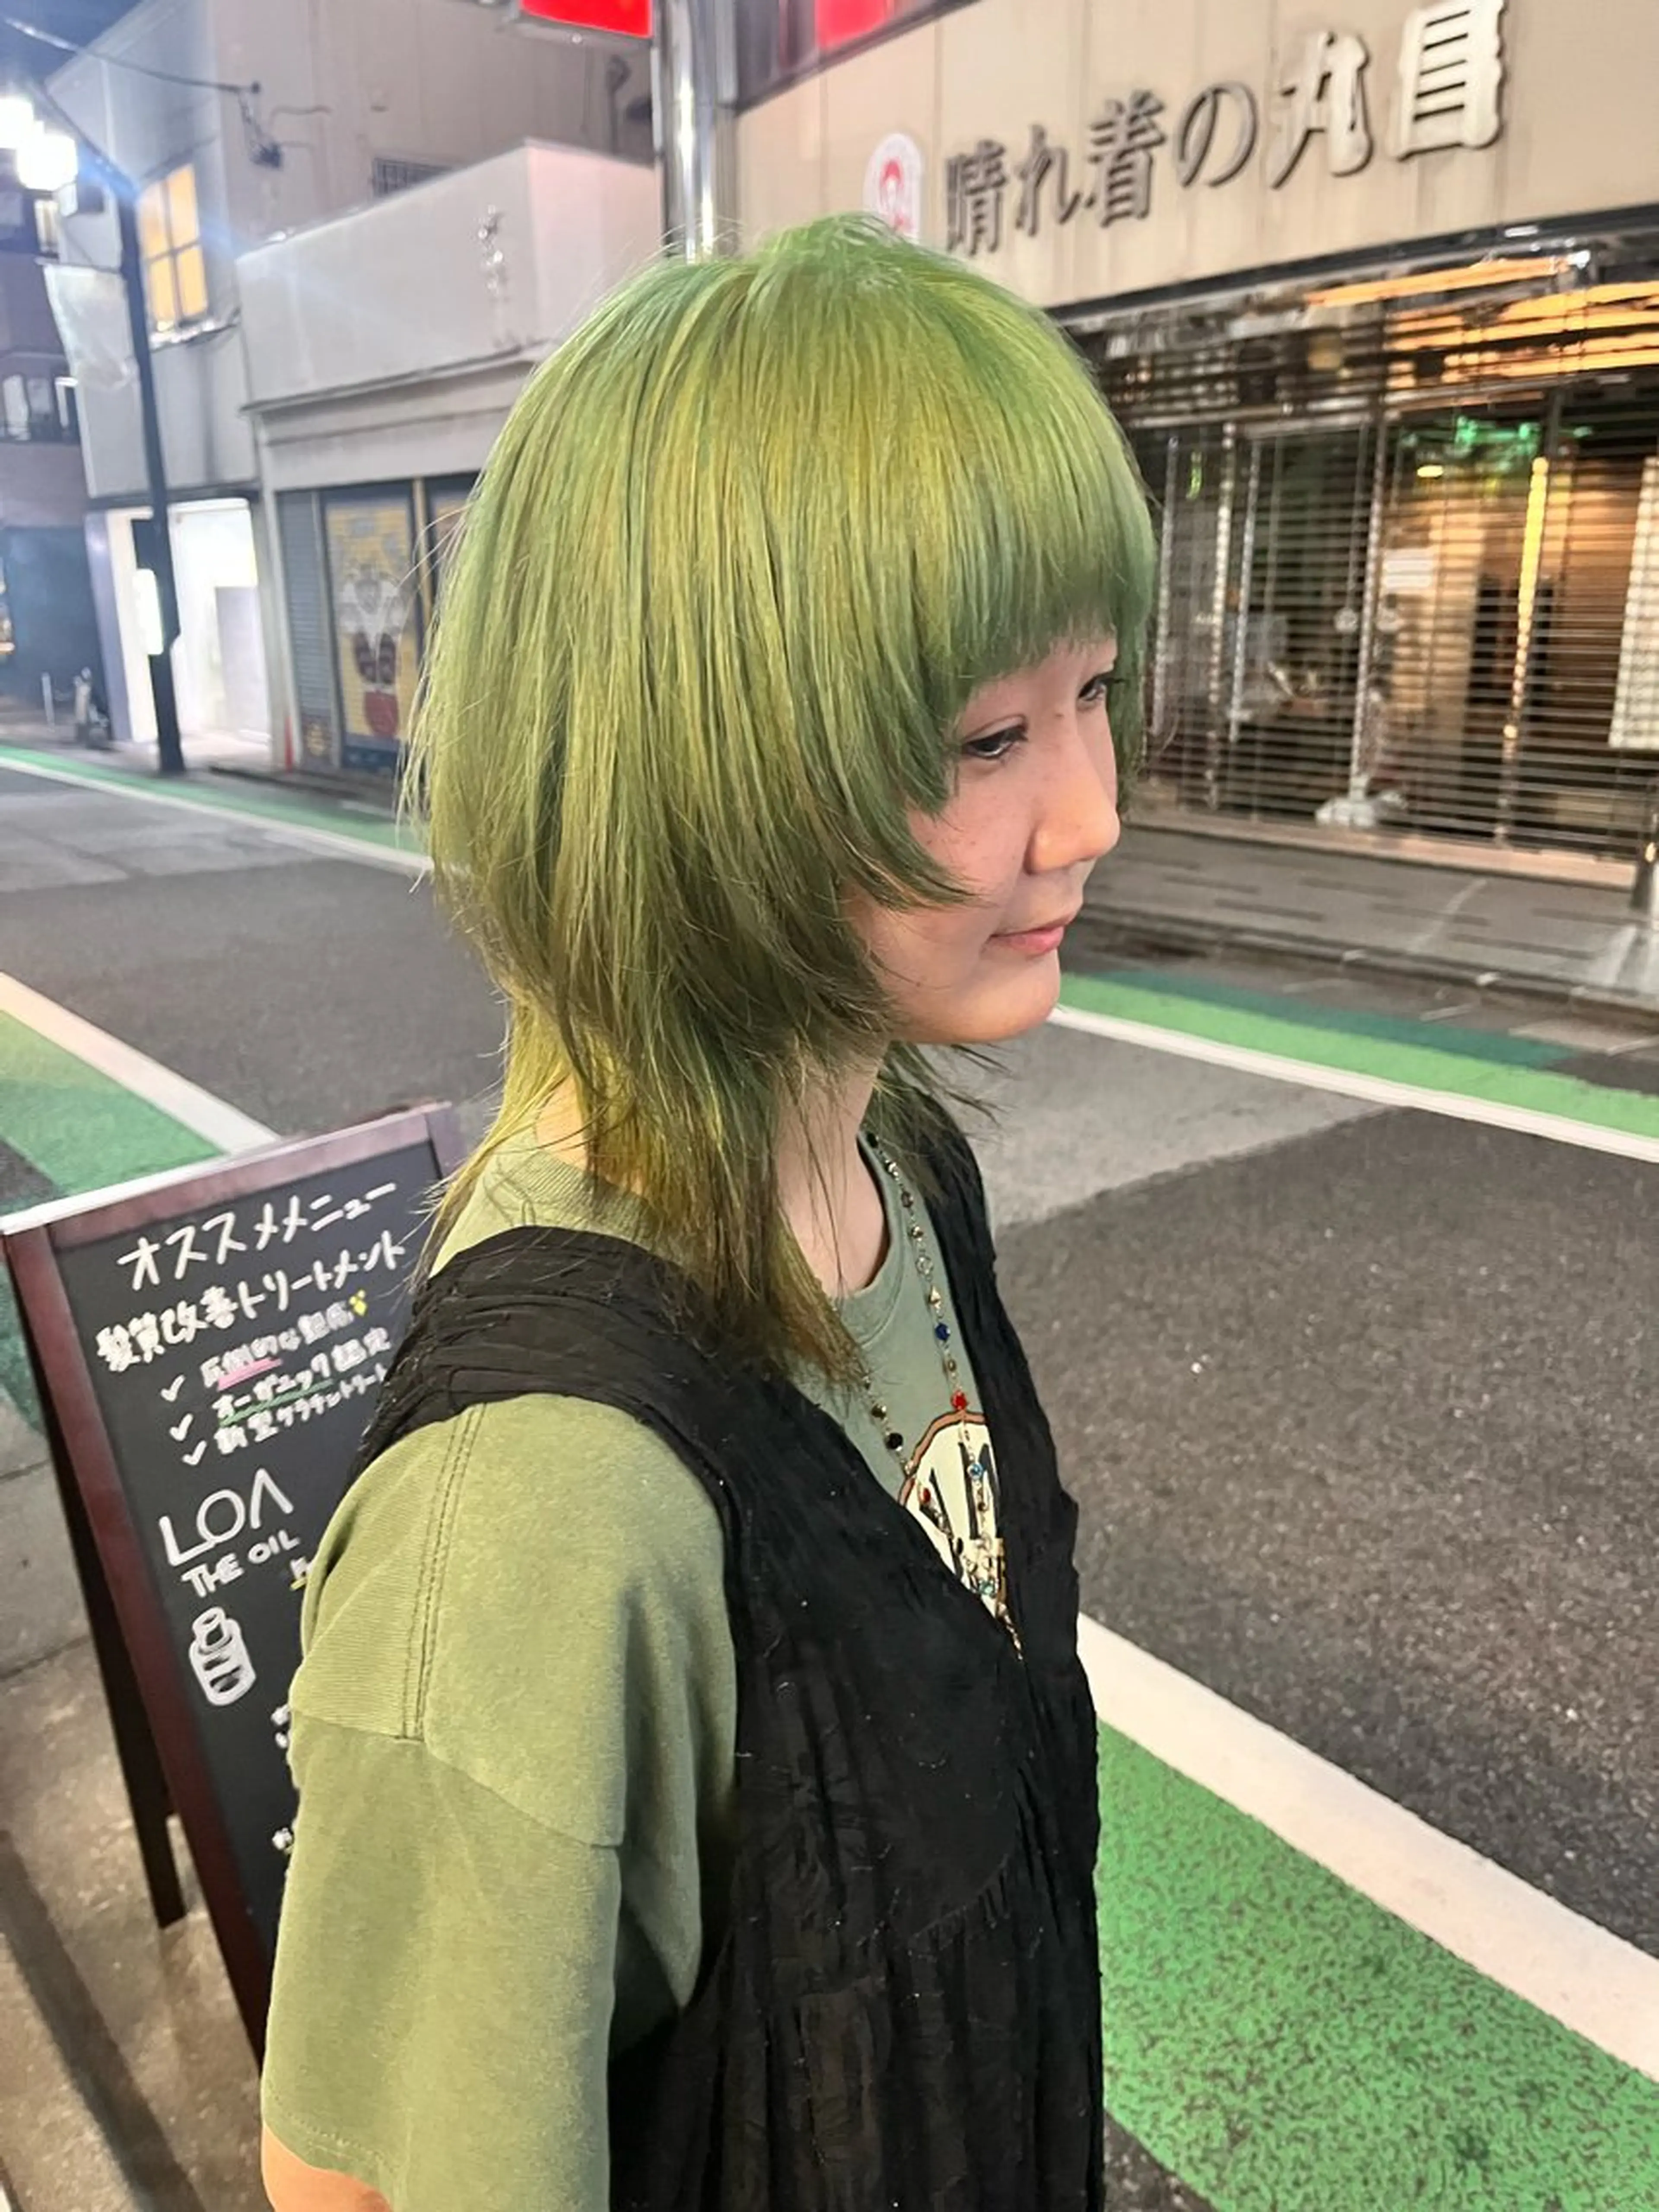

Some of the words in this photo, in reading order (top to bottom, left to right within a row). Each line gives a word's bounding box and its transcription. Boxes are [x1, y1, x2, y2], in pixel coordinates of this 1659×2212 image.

[116, 1182, 397, 1292] オススメメニュー
[95, 1230, 406, 1373] 髪質改善トリートメント
[181, 1552, 245, 1598] THE
[247, 1529, 301, 1564] OIL
